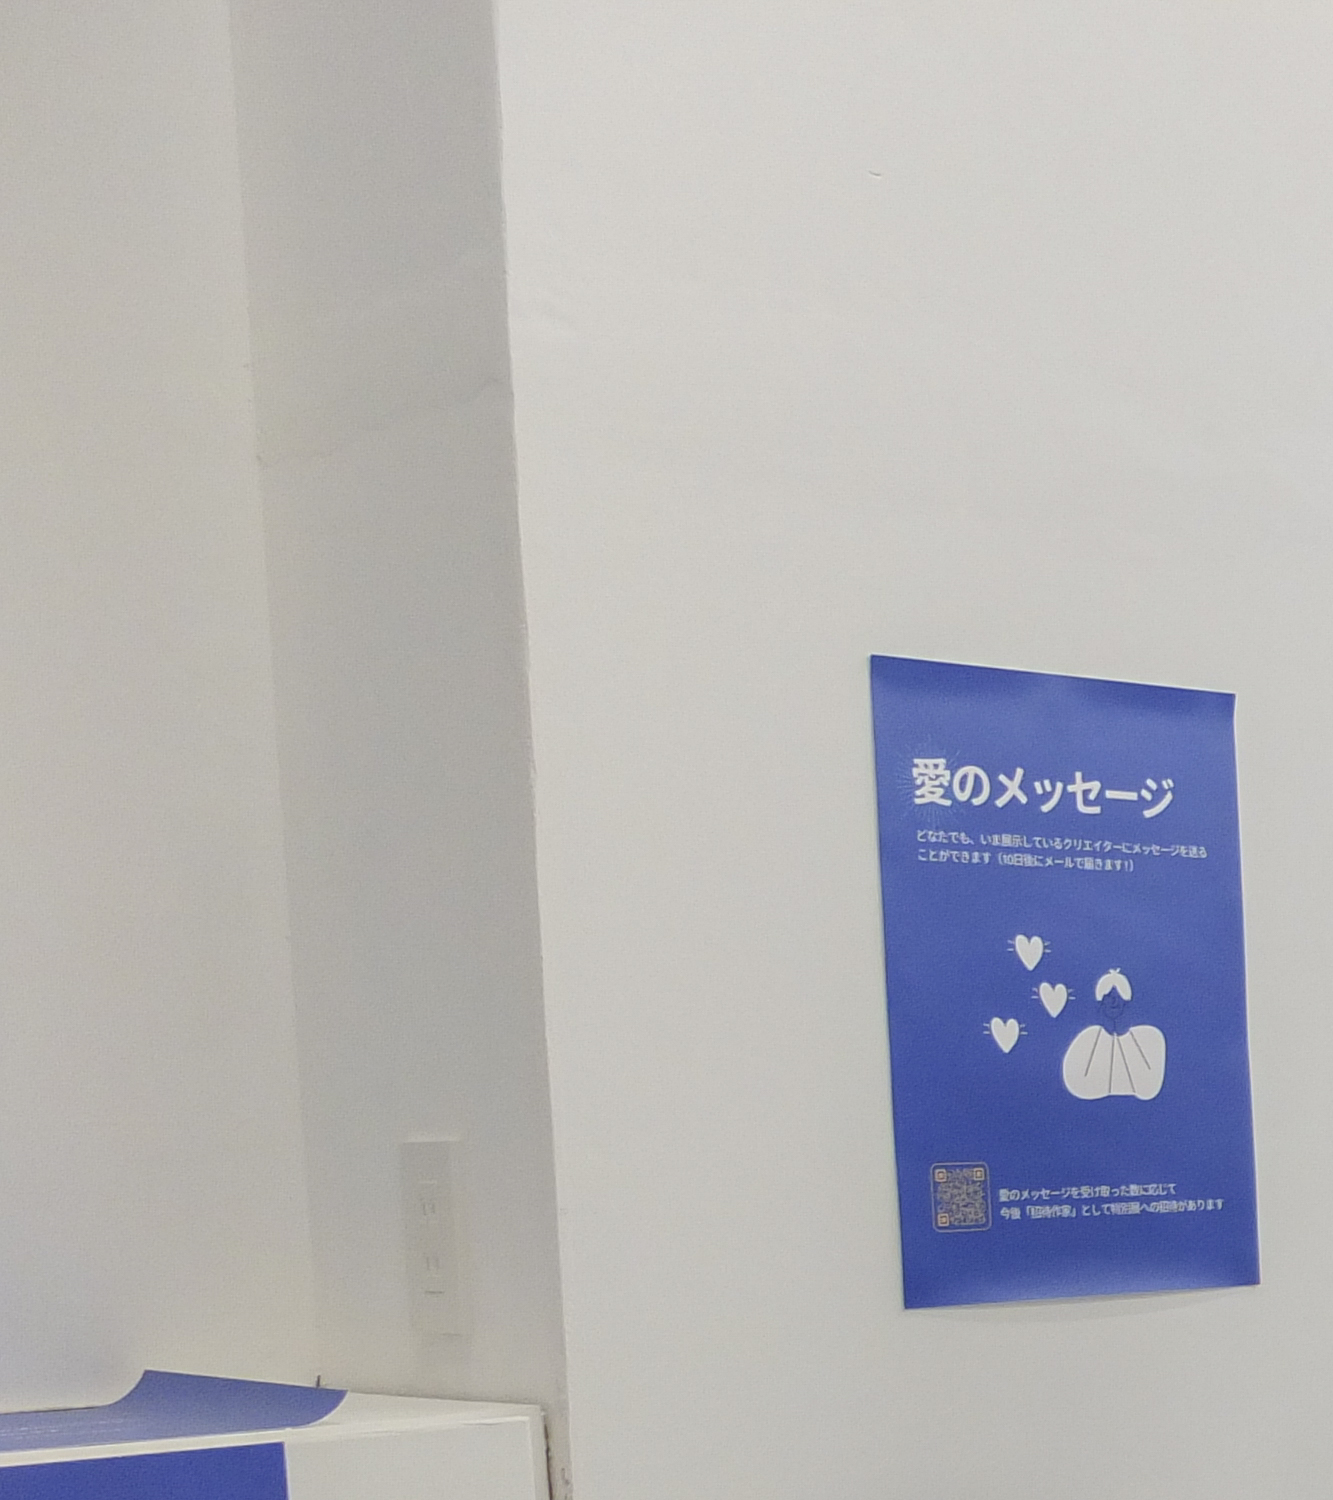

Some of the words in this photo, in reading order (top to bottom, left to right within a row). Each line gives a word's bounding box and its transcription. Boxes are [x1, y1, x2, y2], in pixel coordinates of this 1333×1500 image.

[911, 756, 1174, 819] 愛のメッセージ
